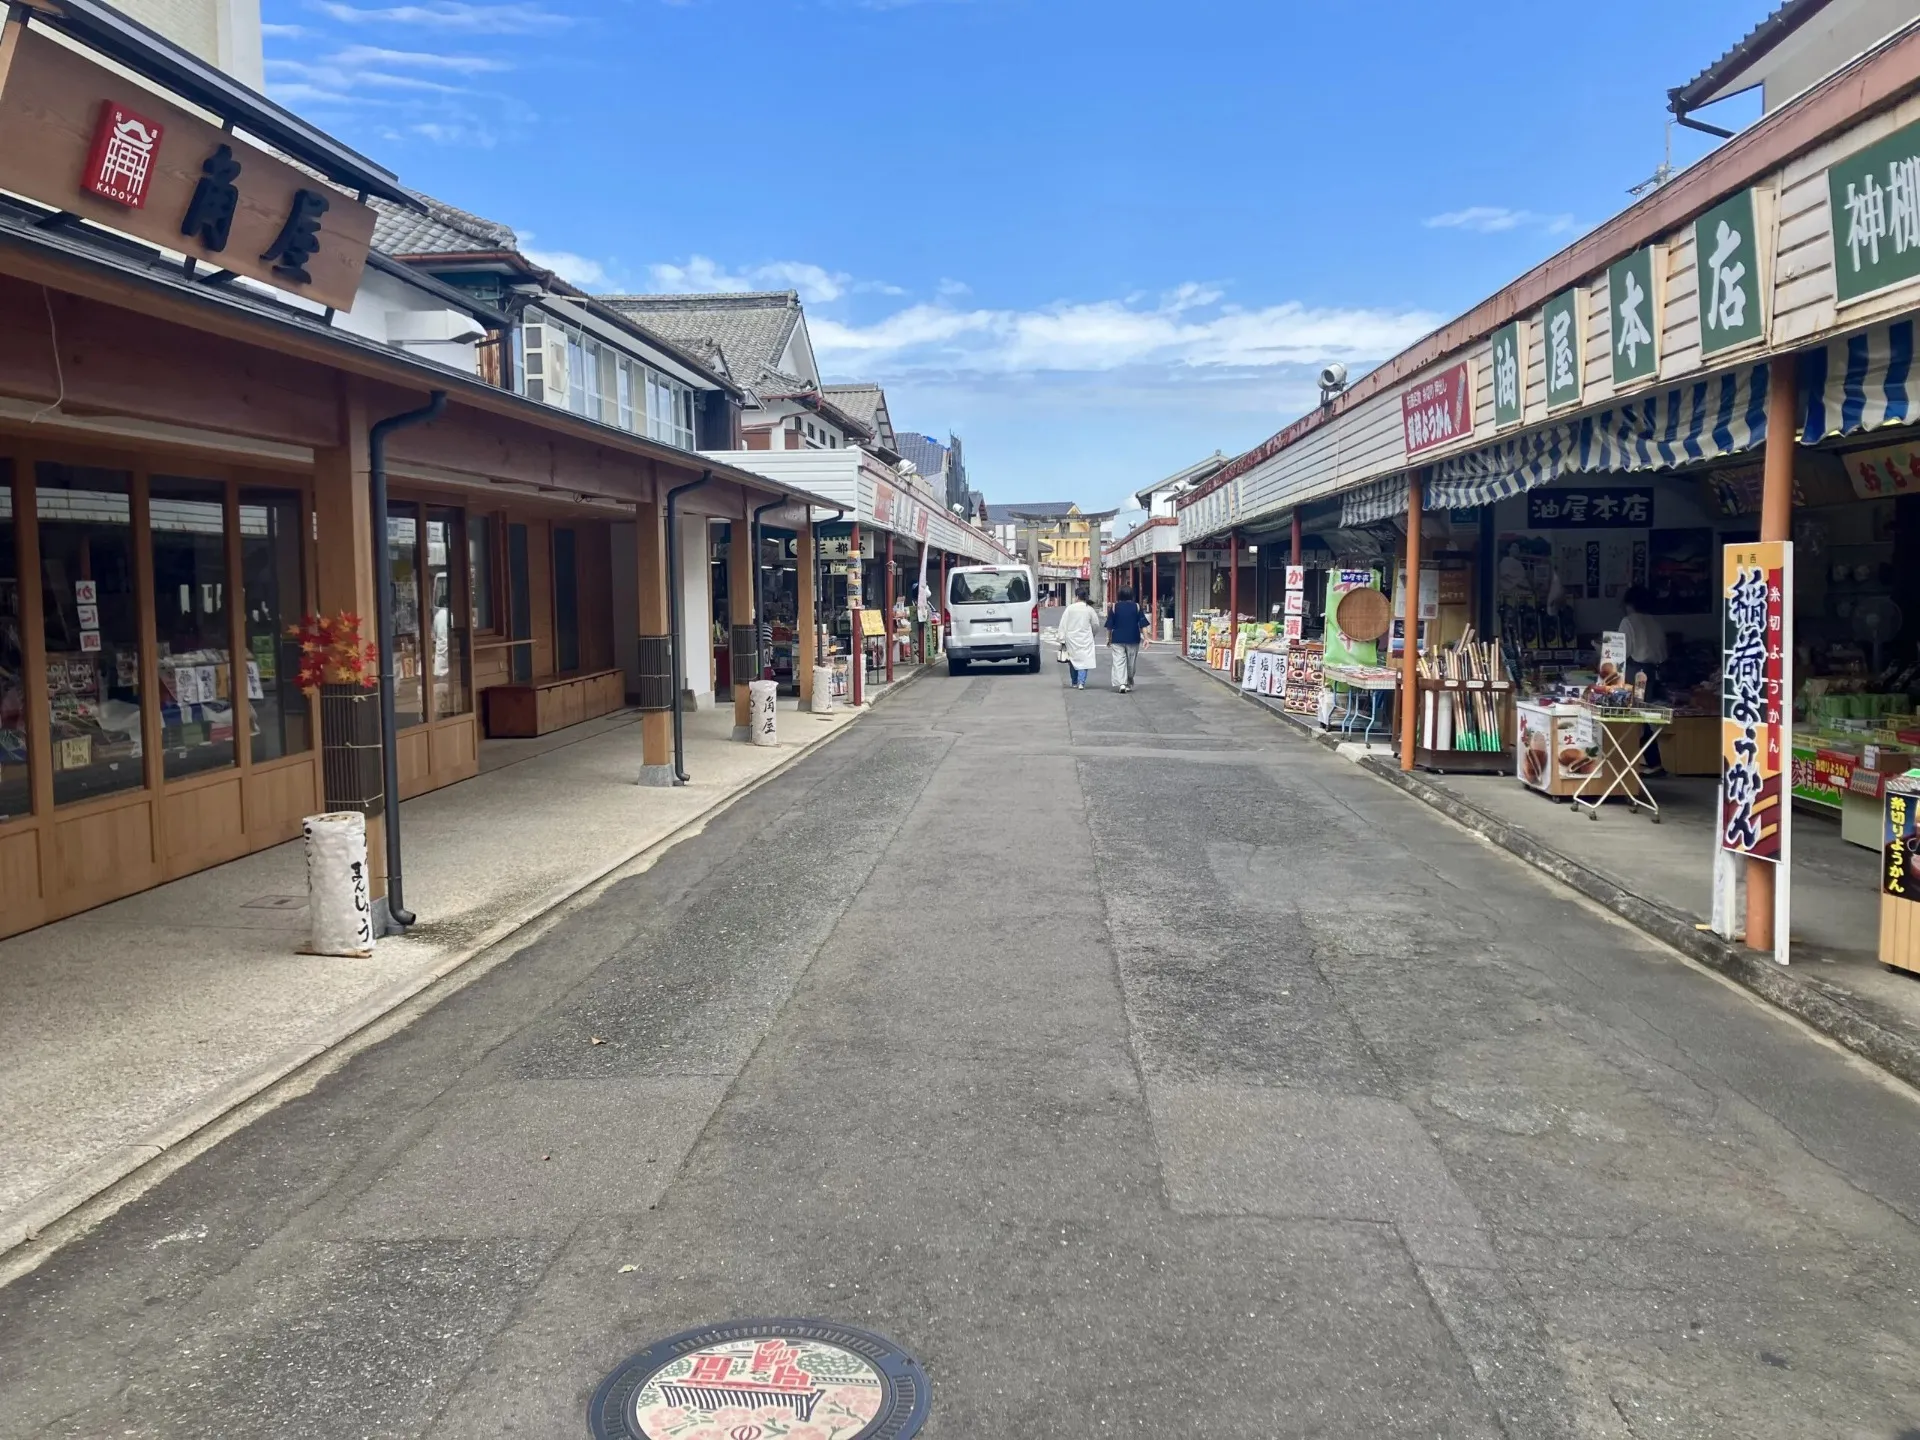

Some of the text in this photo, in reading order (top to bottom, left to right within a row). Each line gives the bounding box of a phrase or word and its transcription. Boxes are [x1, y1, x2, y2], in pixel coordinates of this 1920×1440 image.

[96, 182, 138, 206] KADOYA
[181, 143, 329, 284] 角屋
[1532, 494, 1650, 522] 油屋本店
[1285, 570, 1303, 637] かに漬
[1728, 567, 1767, 849] 稲荷ようかん
[1769, 586, 1781, 753] 糸切ようかん
[762, 695, 776, 734] 角屋
[1889, 797, 1906, 893] 糸切りようかん
